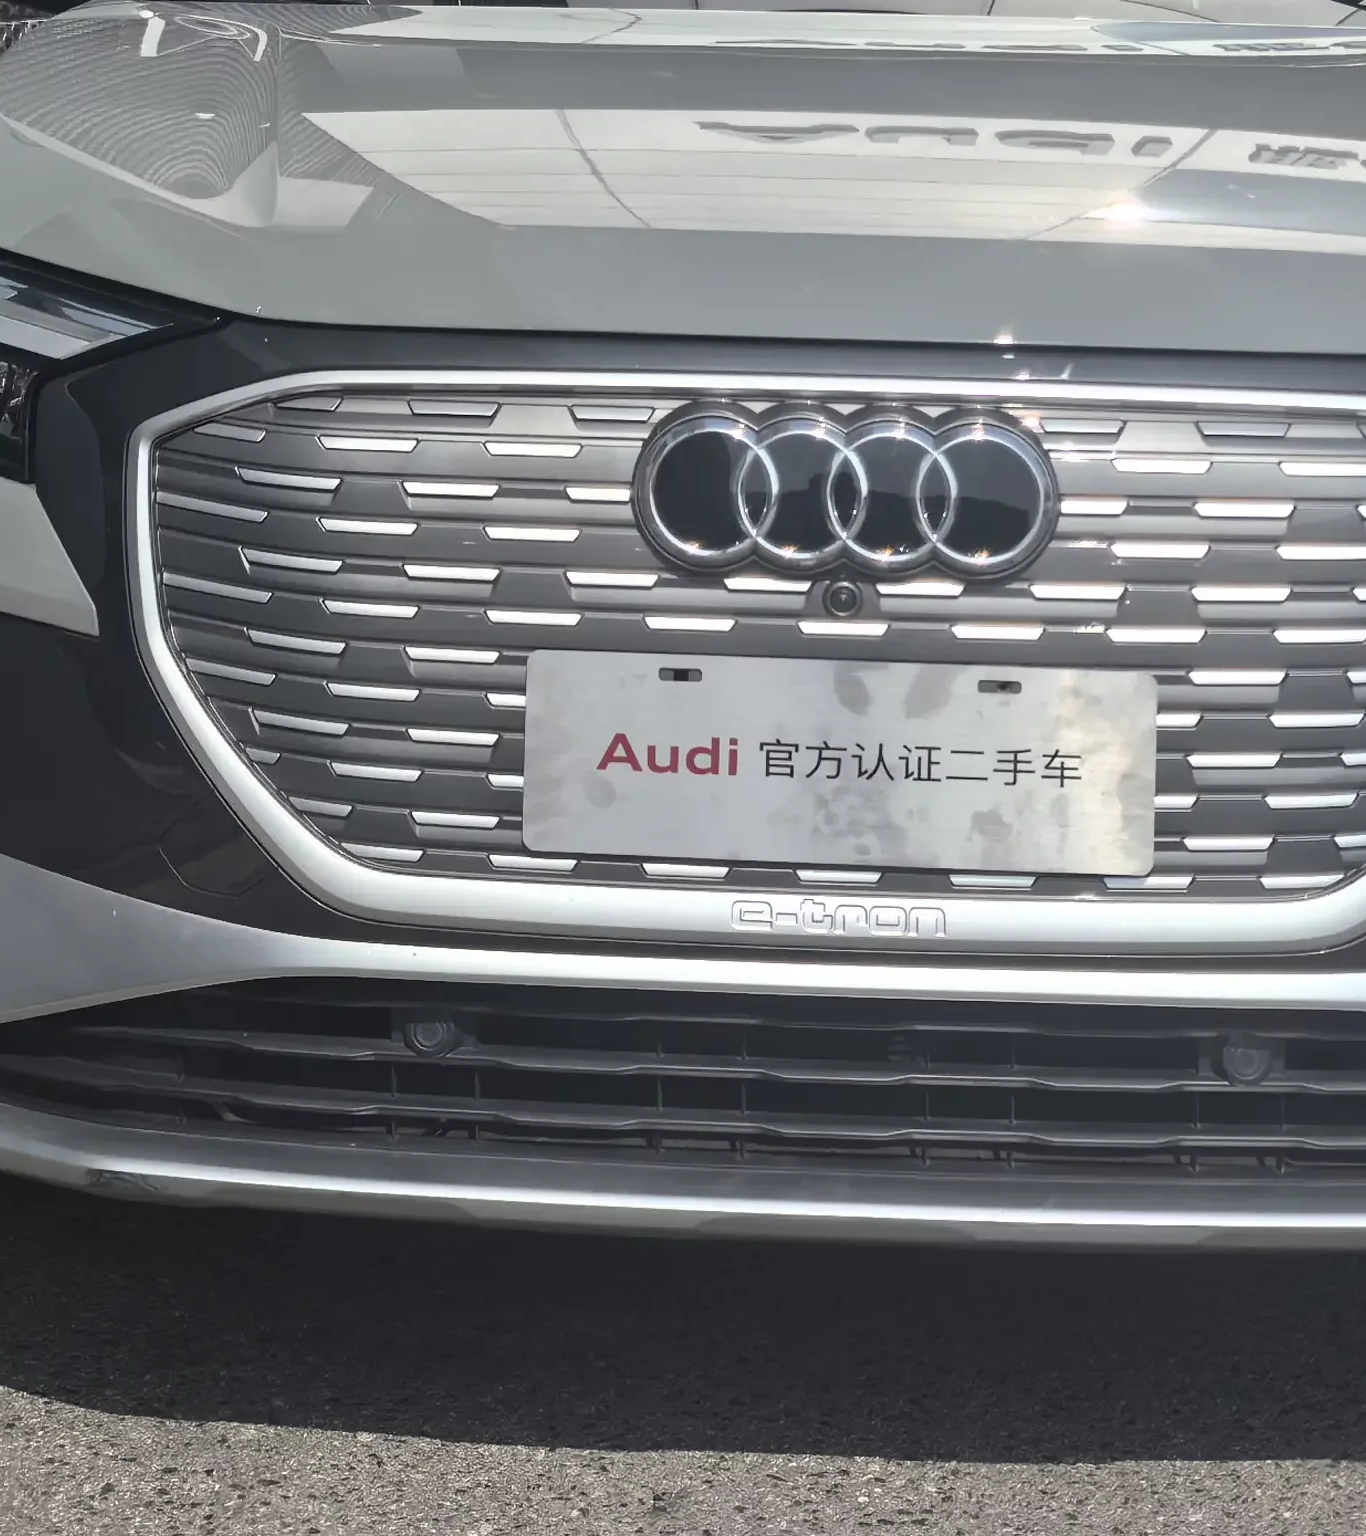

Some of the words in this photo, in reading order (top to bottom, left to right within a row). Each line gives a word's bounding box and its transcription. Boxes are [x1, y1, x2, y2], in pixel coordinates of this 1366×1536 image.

[596, 732, 739, 777] Audi
[758, 739, 1083, 788] 官方认证二手车
[731, 898, 947, 938] e-tron
